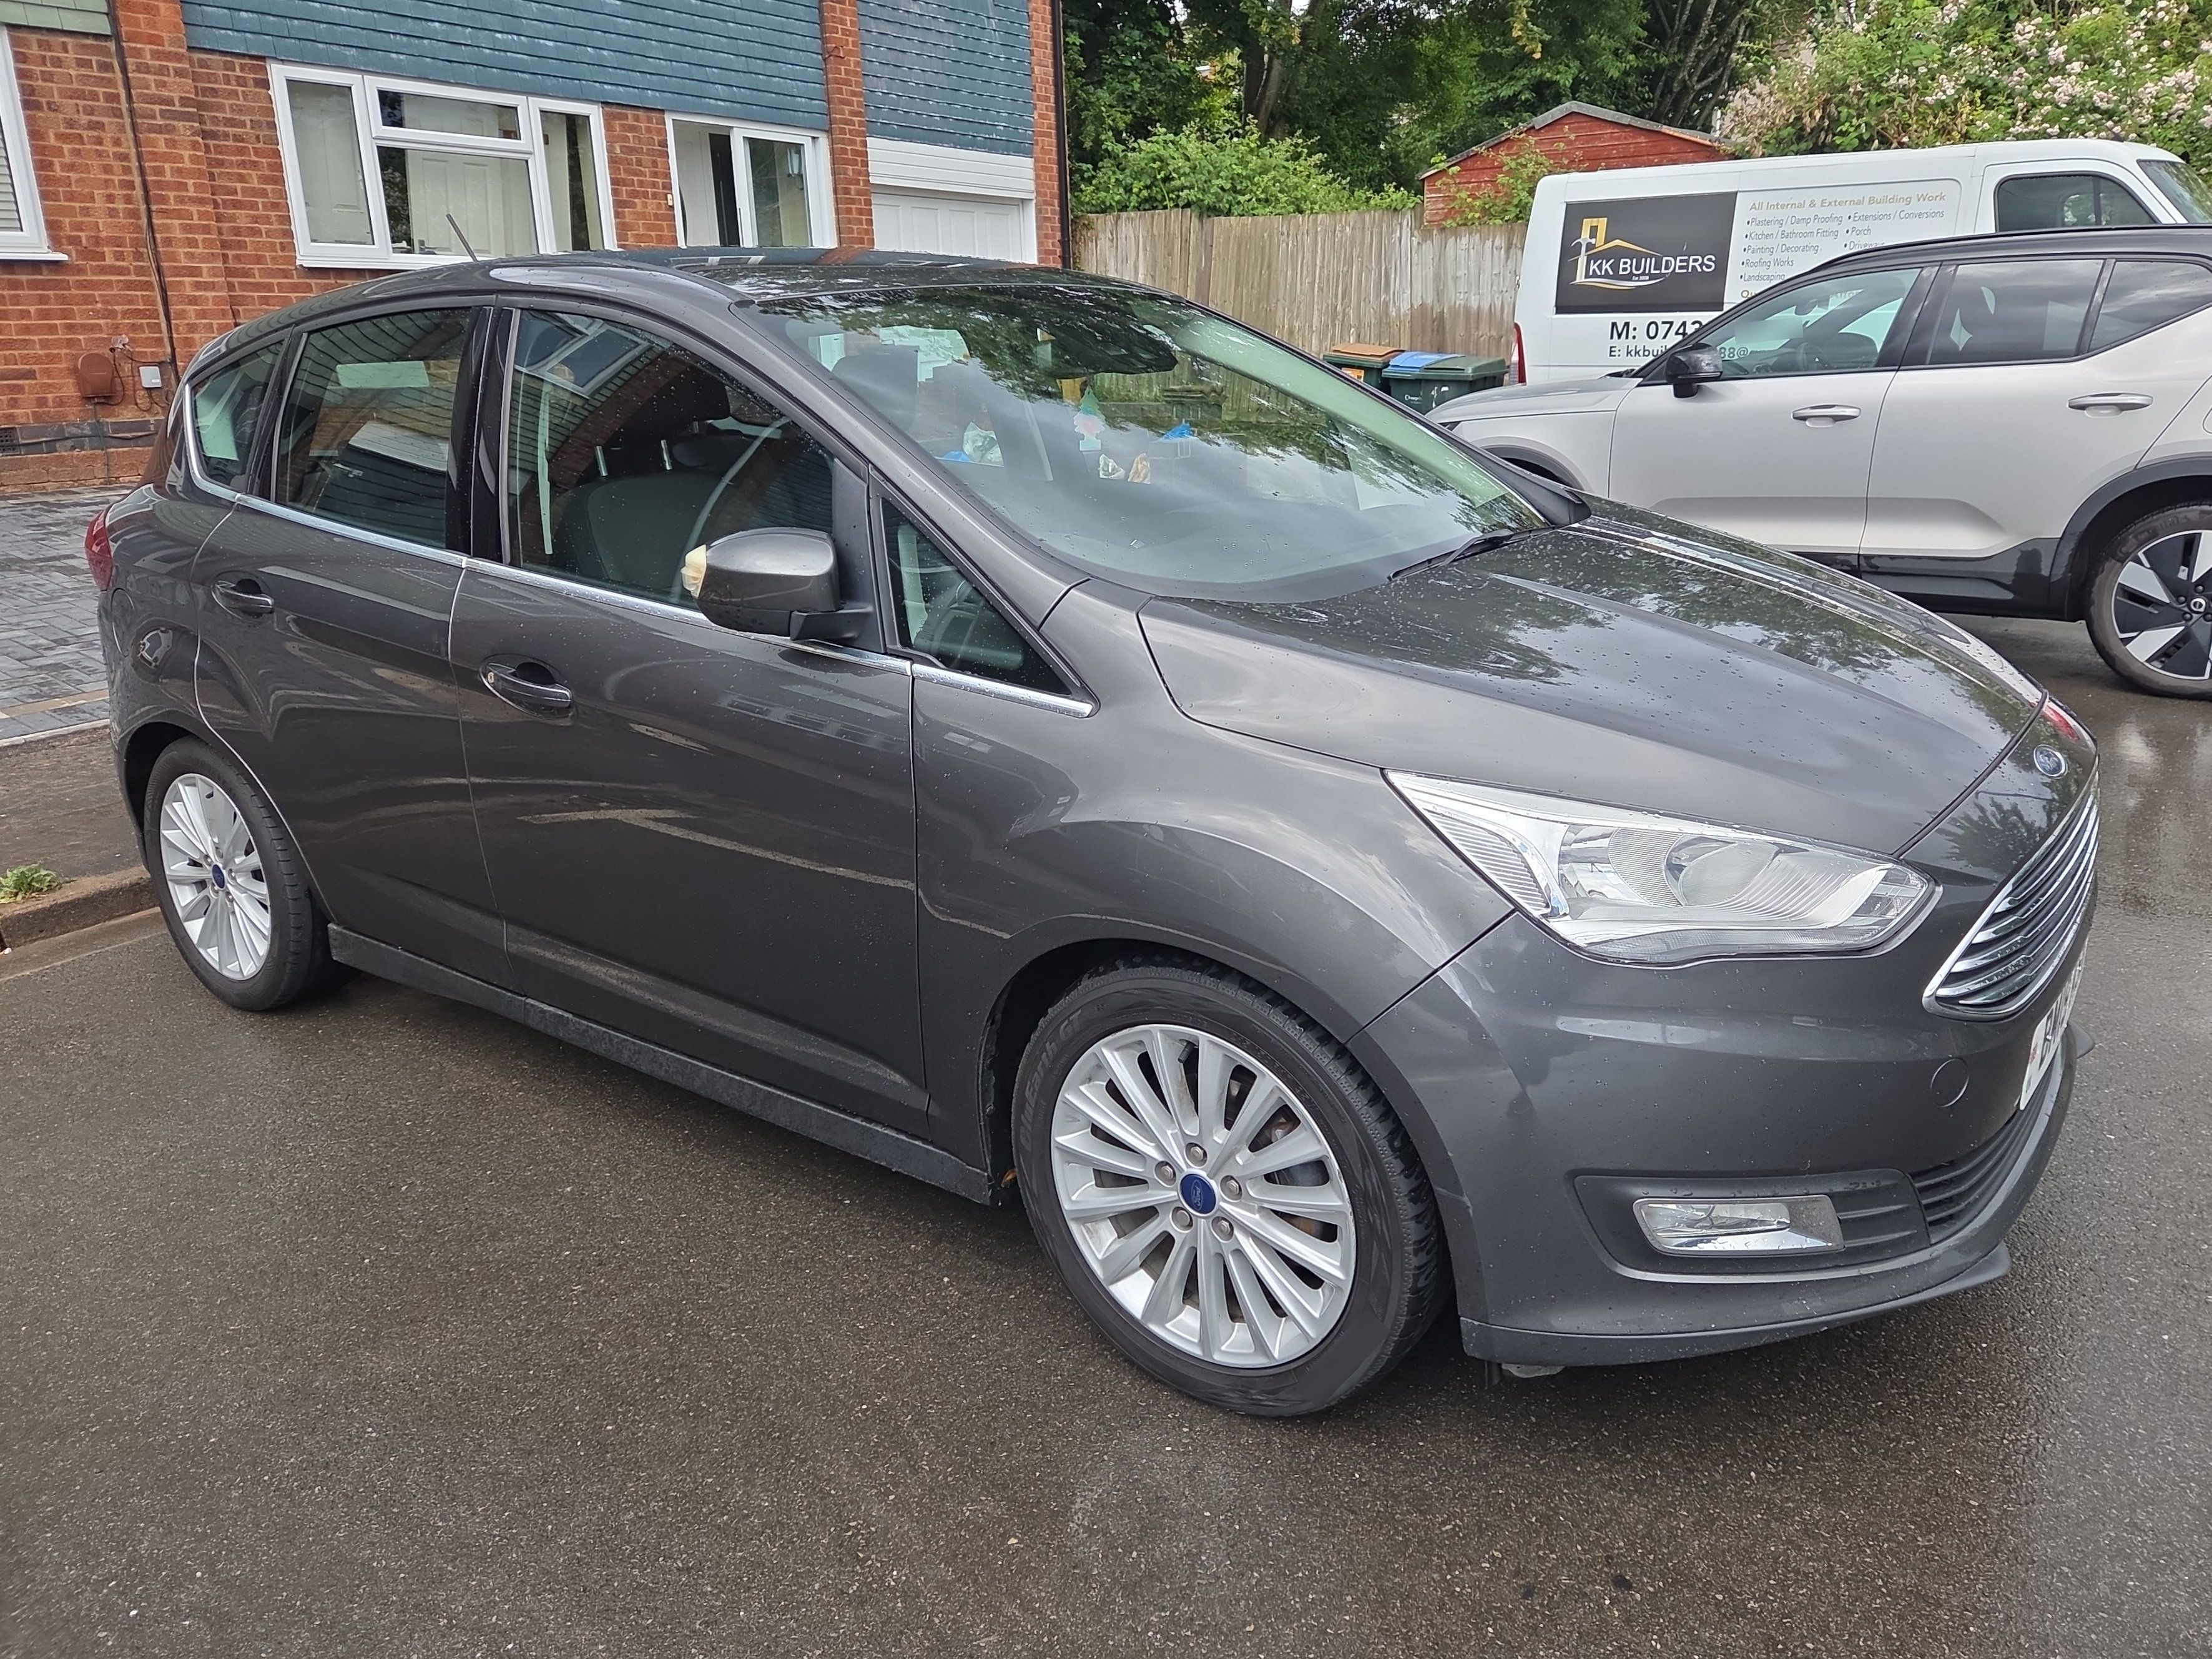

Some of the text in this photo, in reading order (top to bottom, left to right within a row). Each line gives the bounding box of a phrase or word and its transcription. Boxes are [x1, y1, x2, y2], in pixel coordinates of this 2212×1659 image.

[1749, 191, 1947, 211] All Internal & External Building Work
[1750, 216, 1784, 229] Plastering
[1790, 215, 1811, 226] Damp
[1813, 212, 1843, 225] Proofing
[1852, 211, 1892, 222] Extensions
[1899, 208, 1945, 220] Conversions
[1748, 230, 1774, 240] Kitchen
[1781, 229, 1814, 240] Bathroom
[1816, 227, 1839, 240] Fitting
[1851, 225, 1872, 236] Porch
[1747, 245, 1774, 256] Painting
[1781, 243, 1819, 255] Decorating
[1589, 254, 1716, 275] KK BUILDERS
[1744, 257, 1794, 270] Roofing Works
[1610, 321, 1637, 340] M:
[1609, 346, 1621, 358] E:
